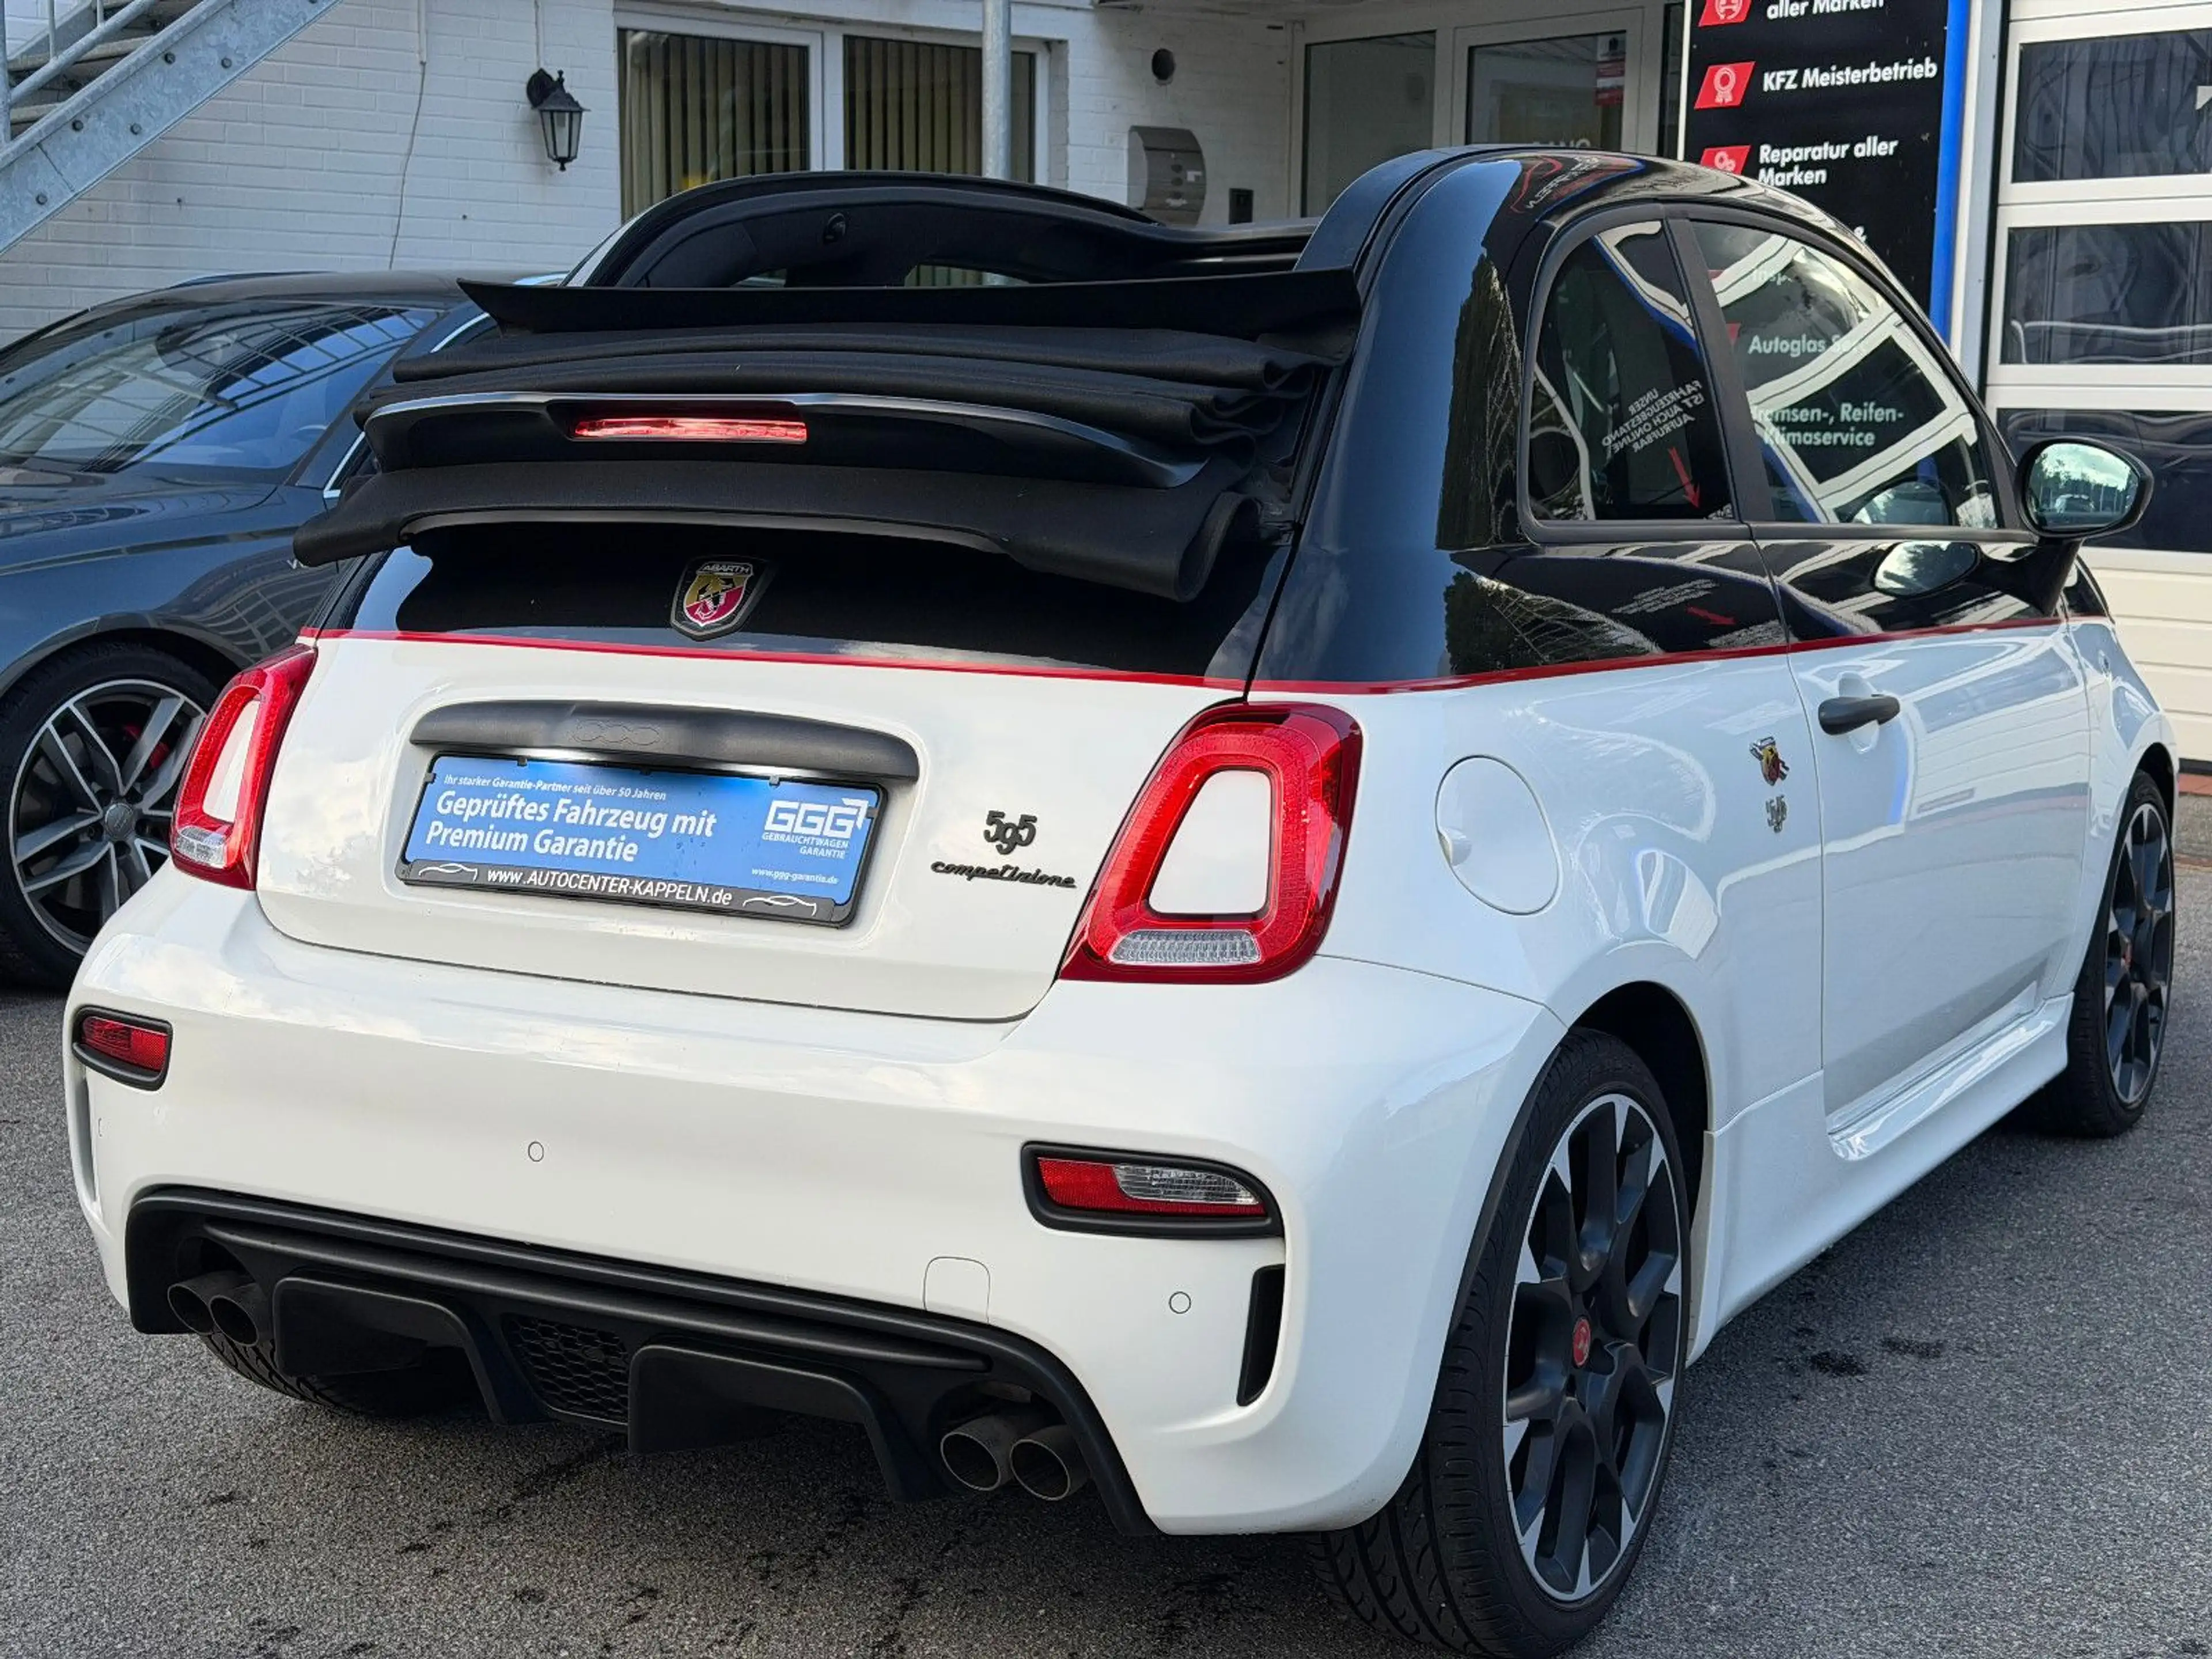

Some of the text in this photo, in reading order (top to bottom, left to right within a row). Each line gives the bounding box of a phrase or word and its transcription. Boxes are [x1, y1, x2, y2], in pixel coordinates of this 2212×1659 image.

[1767, 0, 1808, 20] aller
[1763, 56, 1938, 92] KFZ Meisterbetrieb
[1760, 135, 1899, 167] Reparatur aller
[1759, 165, 1827, 186] Marken
[1748, 334, 1827, 357] Autoglas
[1840, 402, 1904, 422] Reifen-
[703, 565, 749, 573] ABARTH
[444, 774, 666, 800] Ihr starker Garantie-Partner seit über 50 Jahren
[437, 790, 717, 839] Geprüftes Fahrzeug mit
[764, 800, 858, 839] GGG
[426, 820, 638, 862] Premium Garantie
[762, 832, 849, 849] GEBRAUCHTWAGEN
[983, 810, 1037, 855] 595
[800, 846, 846, 859] GARANTIE
[752, 868, 839, 884] www.ggg-garantie.de
